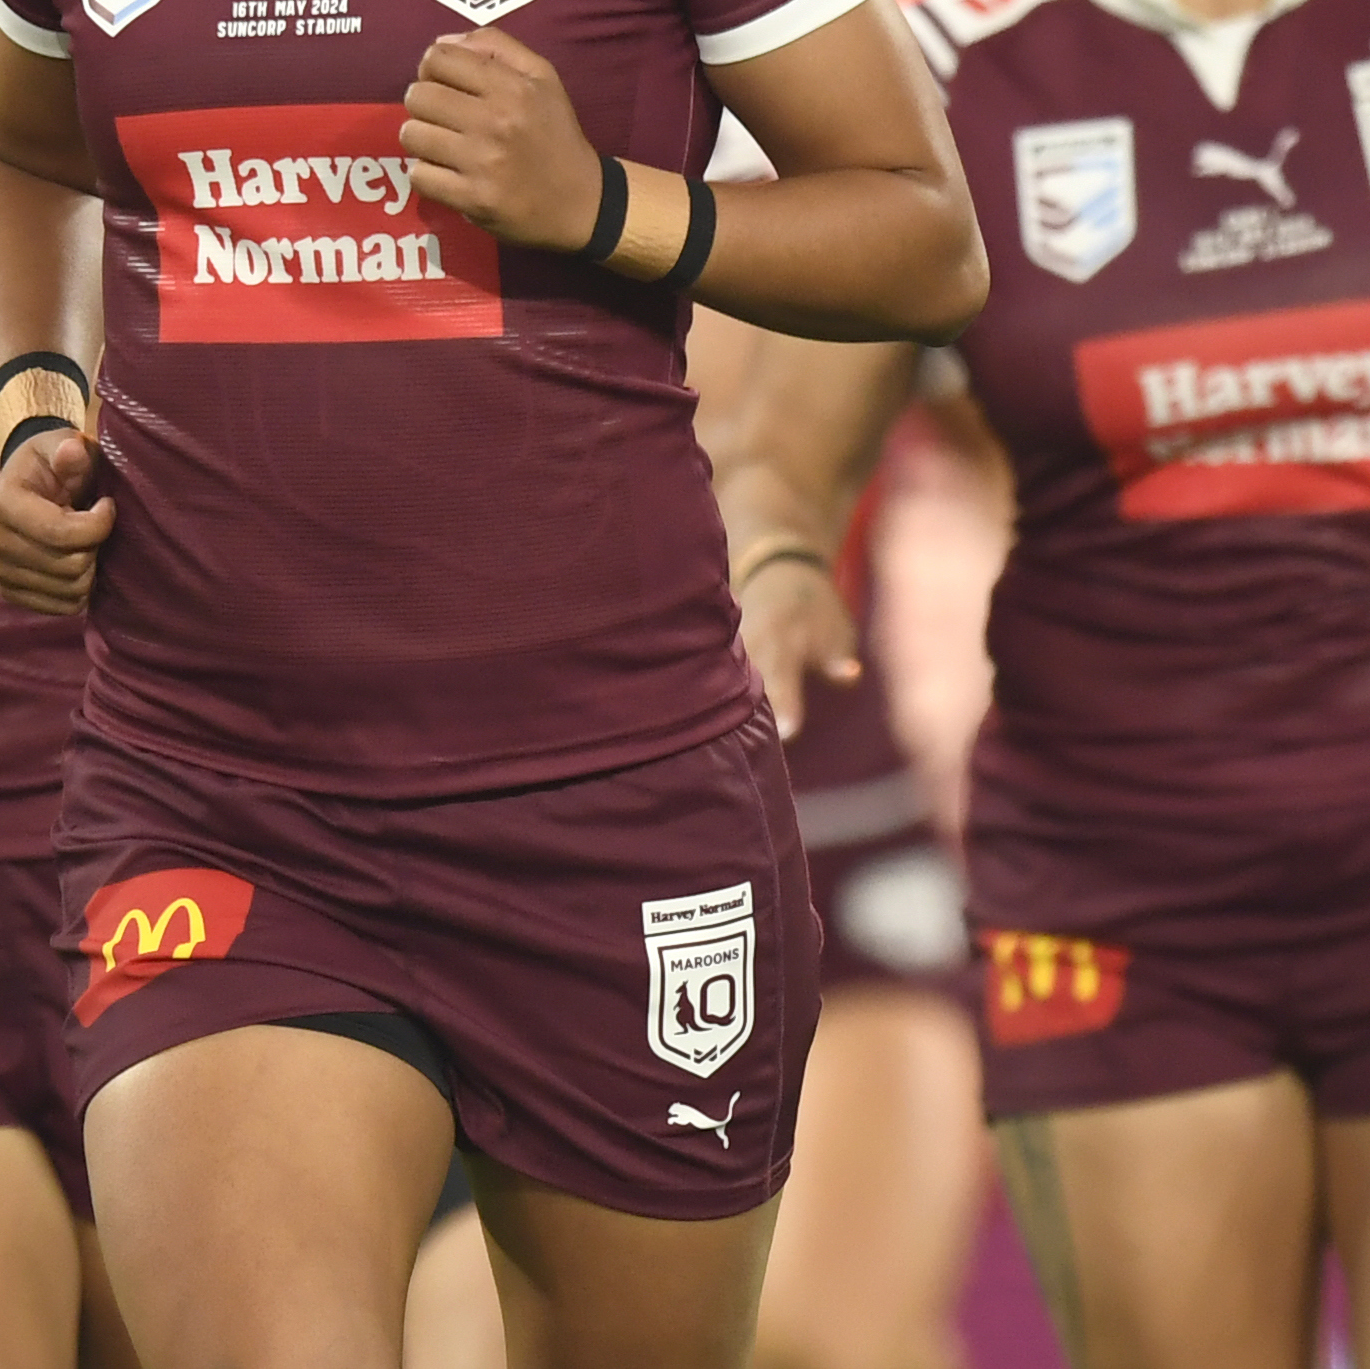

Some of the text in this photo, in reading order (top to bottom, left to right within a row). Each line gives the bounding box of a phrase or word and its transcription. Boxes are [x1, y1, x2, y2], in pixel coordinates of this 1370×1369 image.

[231, 0, 268, 19] 16TH
[274, 0, 307, 17] MAY
[216, 16, 363, 39] SUNCORP STADIUM
[177, 148, 420, 216] Harvey
[193, 224, 447, 286] Norman
[650, 896, 745, 924] Harvey Norman
[670, 947, 740, 973] MAROONS
